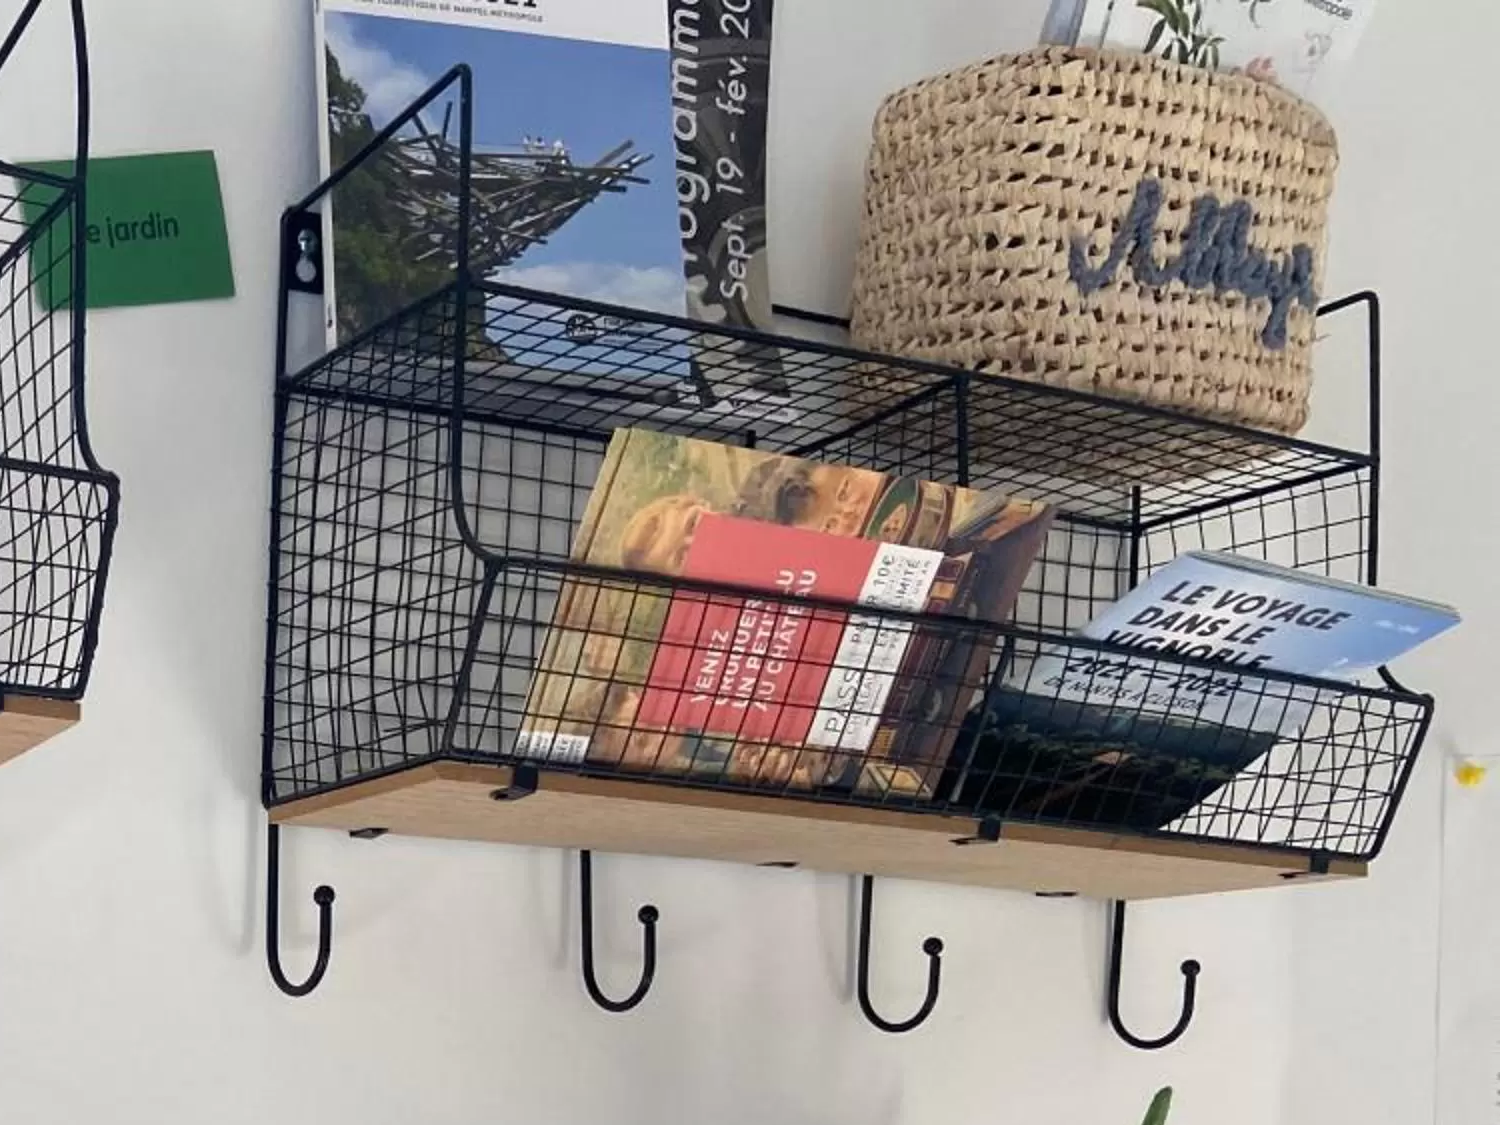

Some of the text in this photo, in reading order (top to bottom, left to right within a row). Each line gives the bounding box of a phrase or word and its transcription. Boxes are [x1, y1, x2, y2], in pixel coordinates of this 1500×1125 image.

[715, 54, 748, 116] fév.
[716, 156, 745, 195] 19
[105, 210, 180, 250] jardin
[720, 213, 753, 301] Sept.
[1126, 606, 1277, 645] DANS LE
[1161, 580, 1354, 630] LE VOYAGE
[690, 629, 729, 703] VENEZ
[731, 677, 758, 708] UN
[753, 681, 777, 713] AU
[823, 667, 859, 733] PASS
